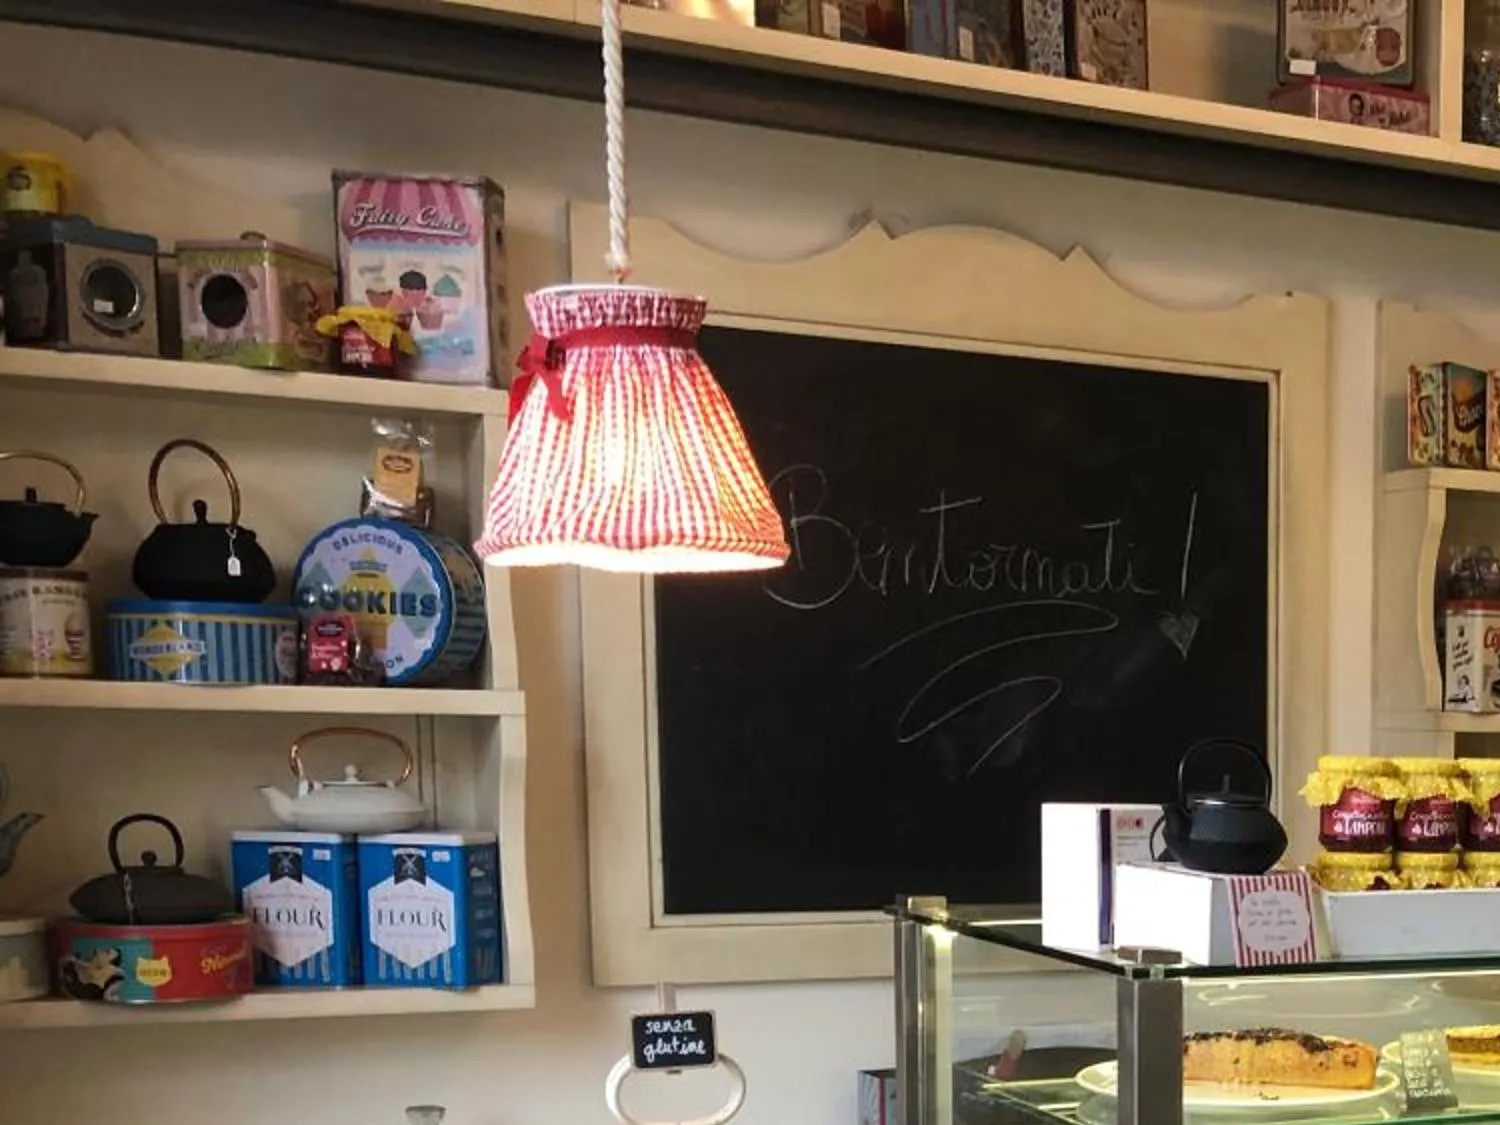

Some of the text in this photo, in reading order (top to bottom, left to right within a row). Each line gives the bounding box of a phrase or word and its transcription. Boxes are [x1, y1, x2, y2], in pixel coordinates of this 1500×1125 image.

[300, 586, 438, 618] COOKIES
[252, 904, 326, 931] FLOUR
[377, 906, 447, 933] FLOUR
[645, 1018, 697, 1035] senza
[643, 1036, 707, 1064] glutine
